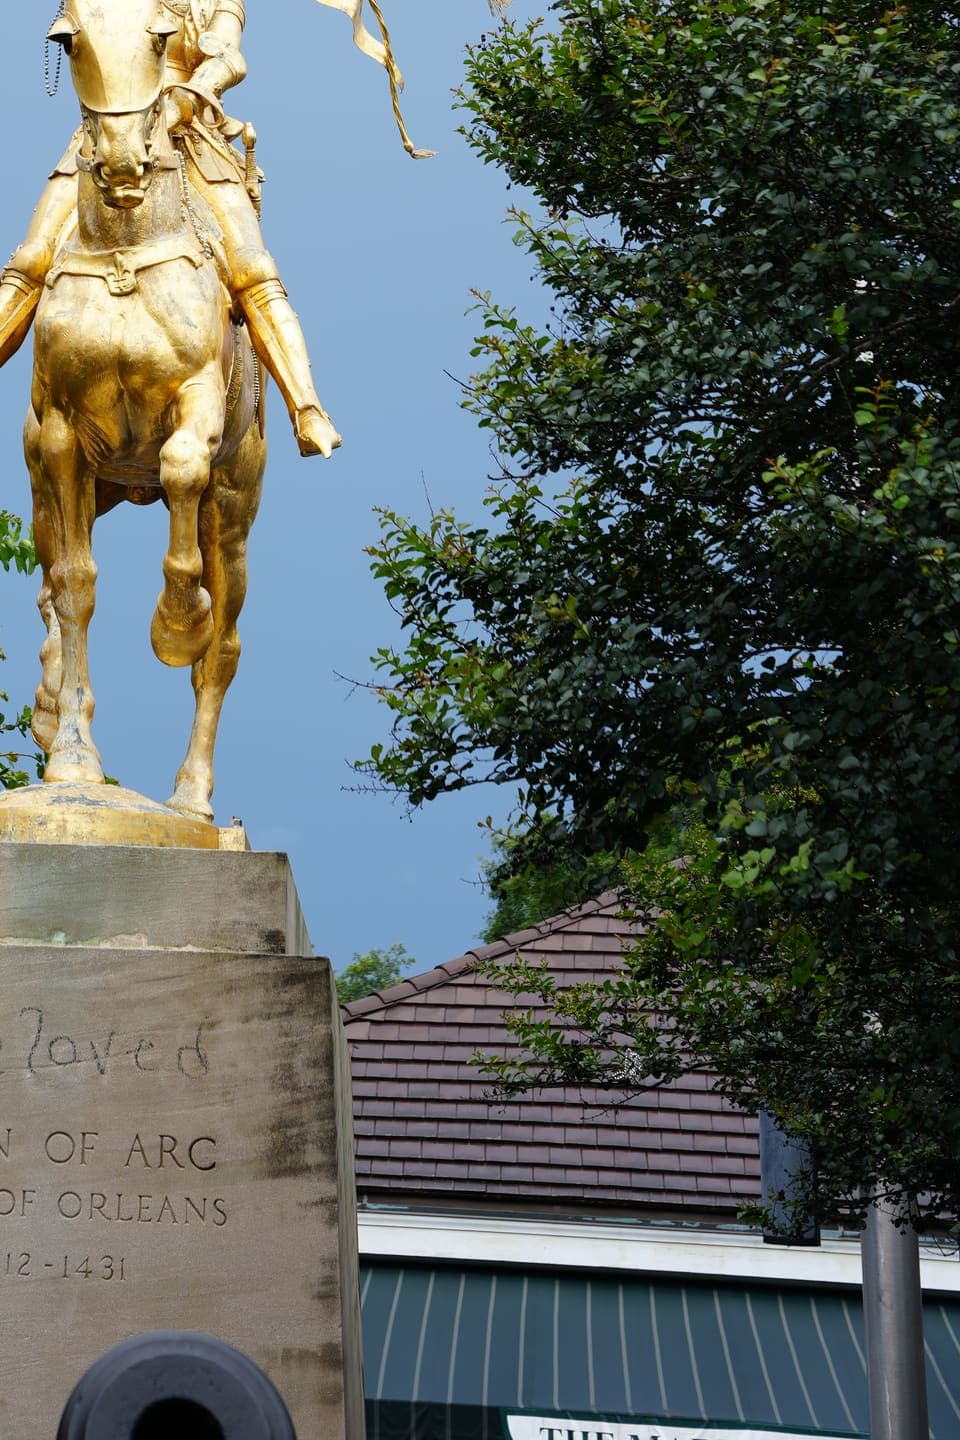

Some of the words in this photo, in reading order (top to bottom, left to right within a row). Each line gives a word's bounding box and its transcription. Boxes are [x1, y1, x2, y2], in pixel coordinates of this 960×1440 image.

[45, 1130, 99, 1164] OF
[124, 1133, 217, 1171] ARC
[57, 1191, 228, 1227] ORLEANS
